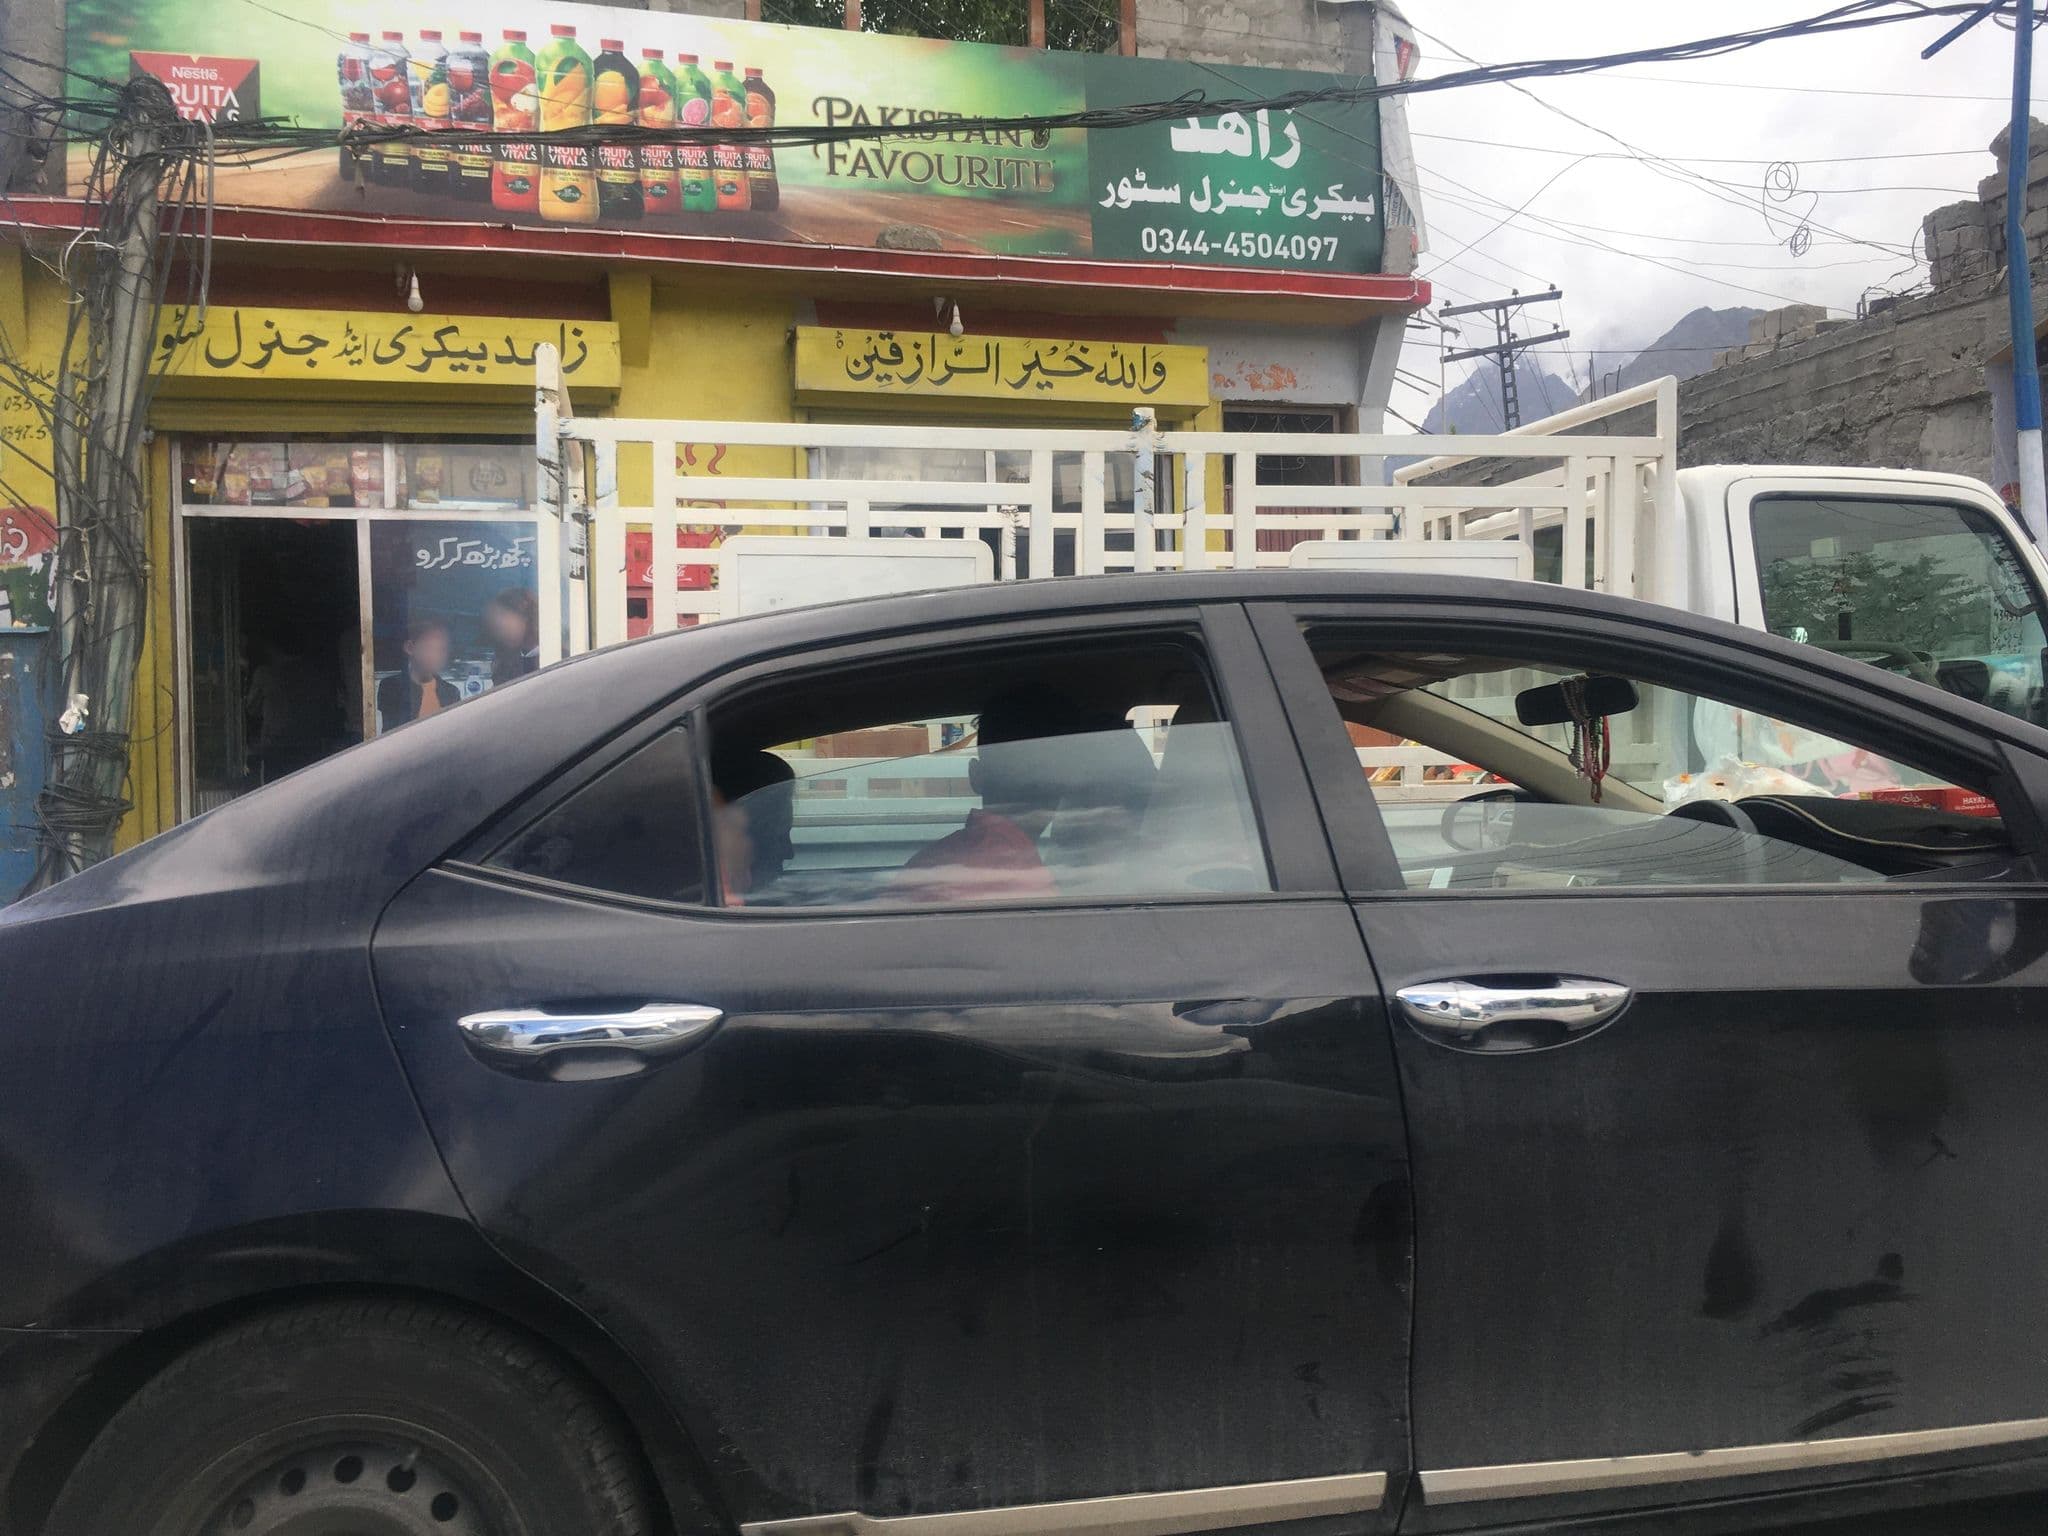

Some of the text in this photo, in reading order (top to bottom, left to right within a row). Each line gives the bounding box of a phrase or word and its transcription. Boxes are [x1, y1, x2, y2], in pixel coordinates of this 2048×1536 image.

[163, 82, 240, 108] RUITA
[501, 149, 538, 160] VITALS
[549, 153, 588, 166] VITALS
[677, 148, 708, 159] FRUITA
[713, 150, 742, 161] FRUITA
[678, 157, 709, 167] VITALS
[714, 158, 743, 168] VITALS
[813, 139, 1054, 192] FAVOURITE
[1189, 175, 1271, 216] جنرل
[1141, 227, 1339, 262] 0344-4504097
[205, 309, 330, 370] جنرل
